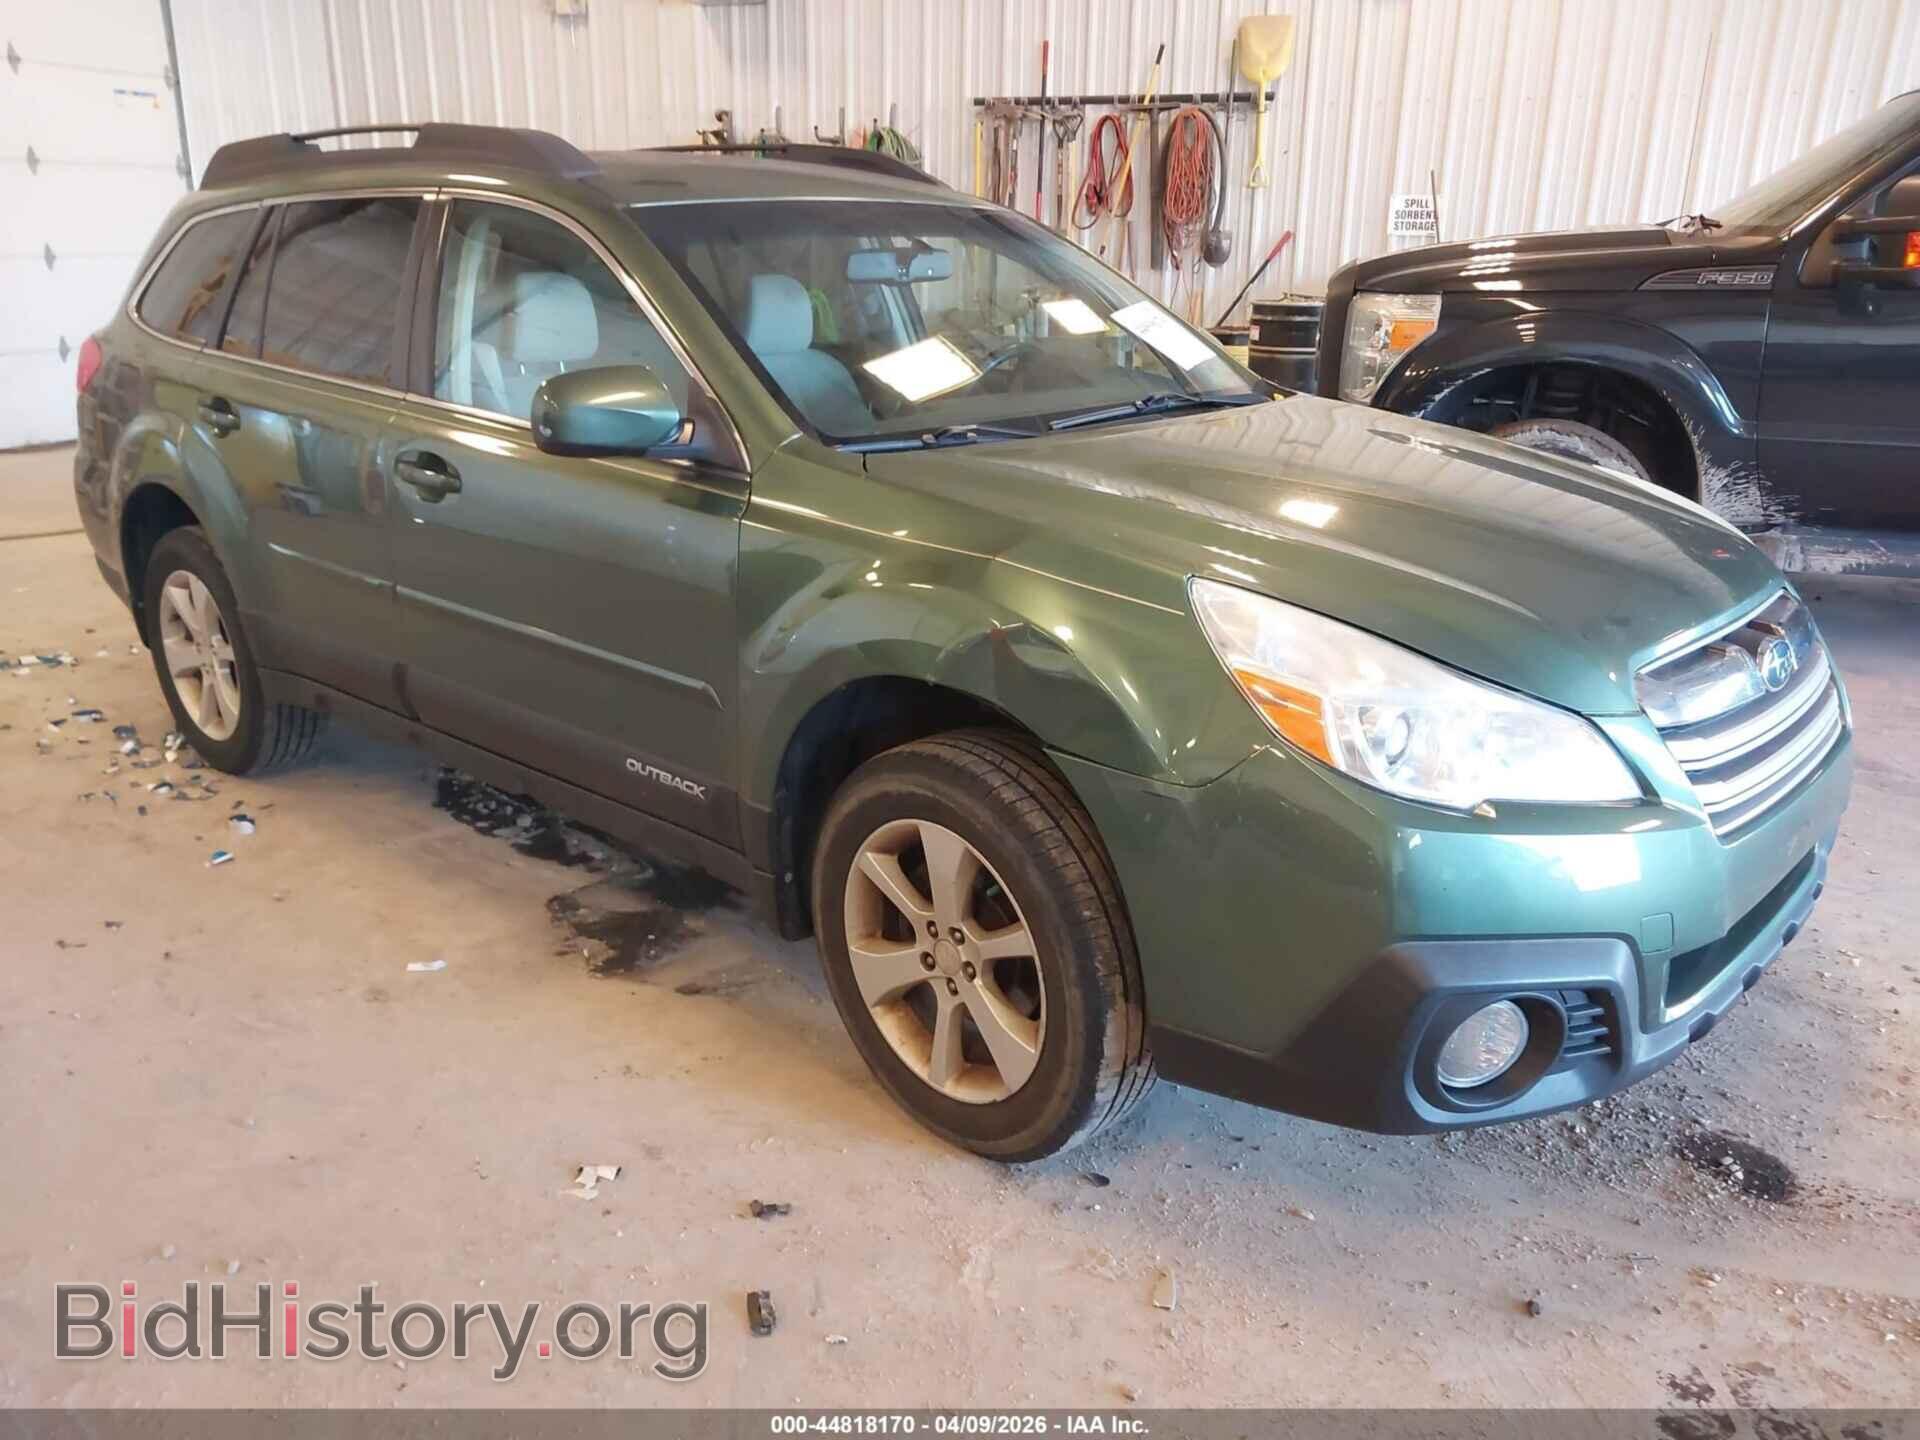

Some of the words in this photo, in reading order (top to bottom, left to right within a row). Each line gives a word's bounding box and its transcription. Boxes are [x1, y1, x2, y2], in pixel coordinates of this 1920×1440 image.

[1404, 199, 1430, 208] SPILL
[1393, 221, 1436, 231] STORAGE
[626, 757, 706, 800] OUTBACK
